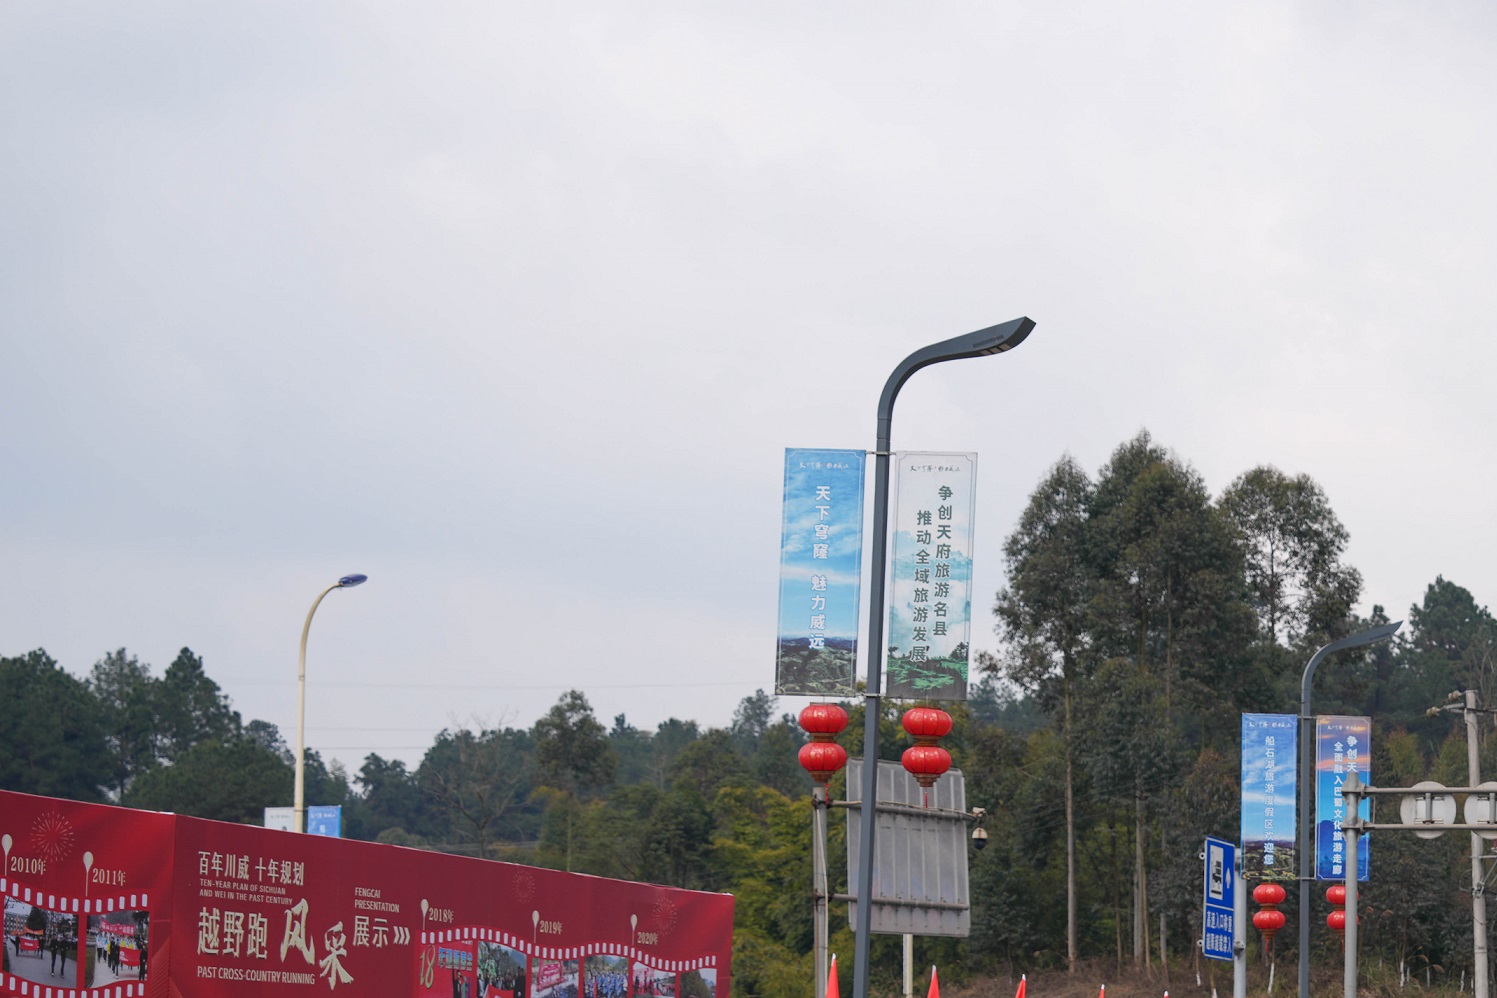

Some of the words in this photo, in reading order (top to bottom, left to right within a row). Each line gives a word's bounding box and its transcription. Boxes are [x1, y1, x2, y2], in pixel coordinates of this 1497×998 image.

[813, 485, 831, 560] 天下穹窿
[932, 485, 953, 636] 争创天府旅游名县
[910, 510, 932, 662] 推动全域旅游发展
[808, 575, 827, 650] 魅力威远
[10, 857, 46, 875] 2010年
[198, 850, 250, 881] 百年川威
[255, 857, 304, 887] 十年规划
[92, 867, 126, 887] 2011年
[200, 878, 231, 889] TEN-YEAR
[232, 880, 249, 891] PLAN
[249, 882, 258, 892] OF
[259, 884, 286, 895] SICHUAN
[199, 888, 213, 898] AND
[214, 889, 227, 899] WEI
[227, 891, 234, 900] IN
[235, 892, 248, 901] THE
[248, 893, 264, 903] PAST
[265, 894, 293, 906] CENTURY
[355, 887, 381, 899] FENGCAI
[354, 899, 400, 913] PRESENTATION
[428, 907, 454, 924] 2018年
[539, 919, 563, 935] 2019年
[197, 906, 268, 960] 越野跑
[280, 898, 354, 990] 风采
[352, 915, 389, 948] 展示
[197, 966, 217, 979] PAST
[218, 967, 281, 983] CROSS-COUNTRY
[281, 970, 315, 985] RUNNING
